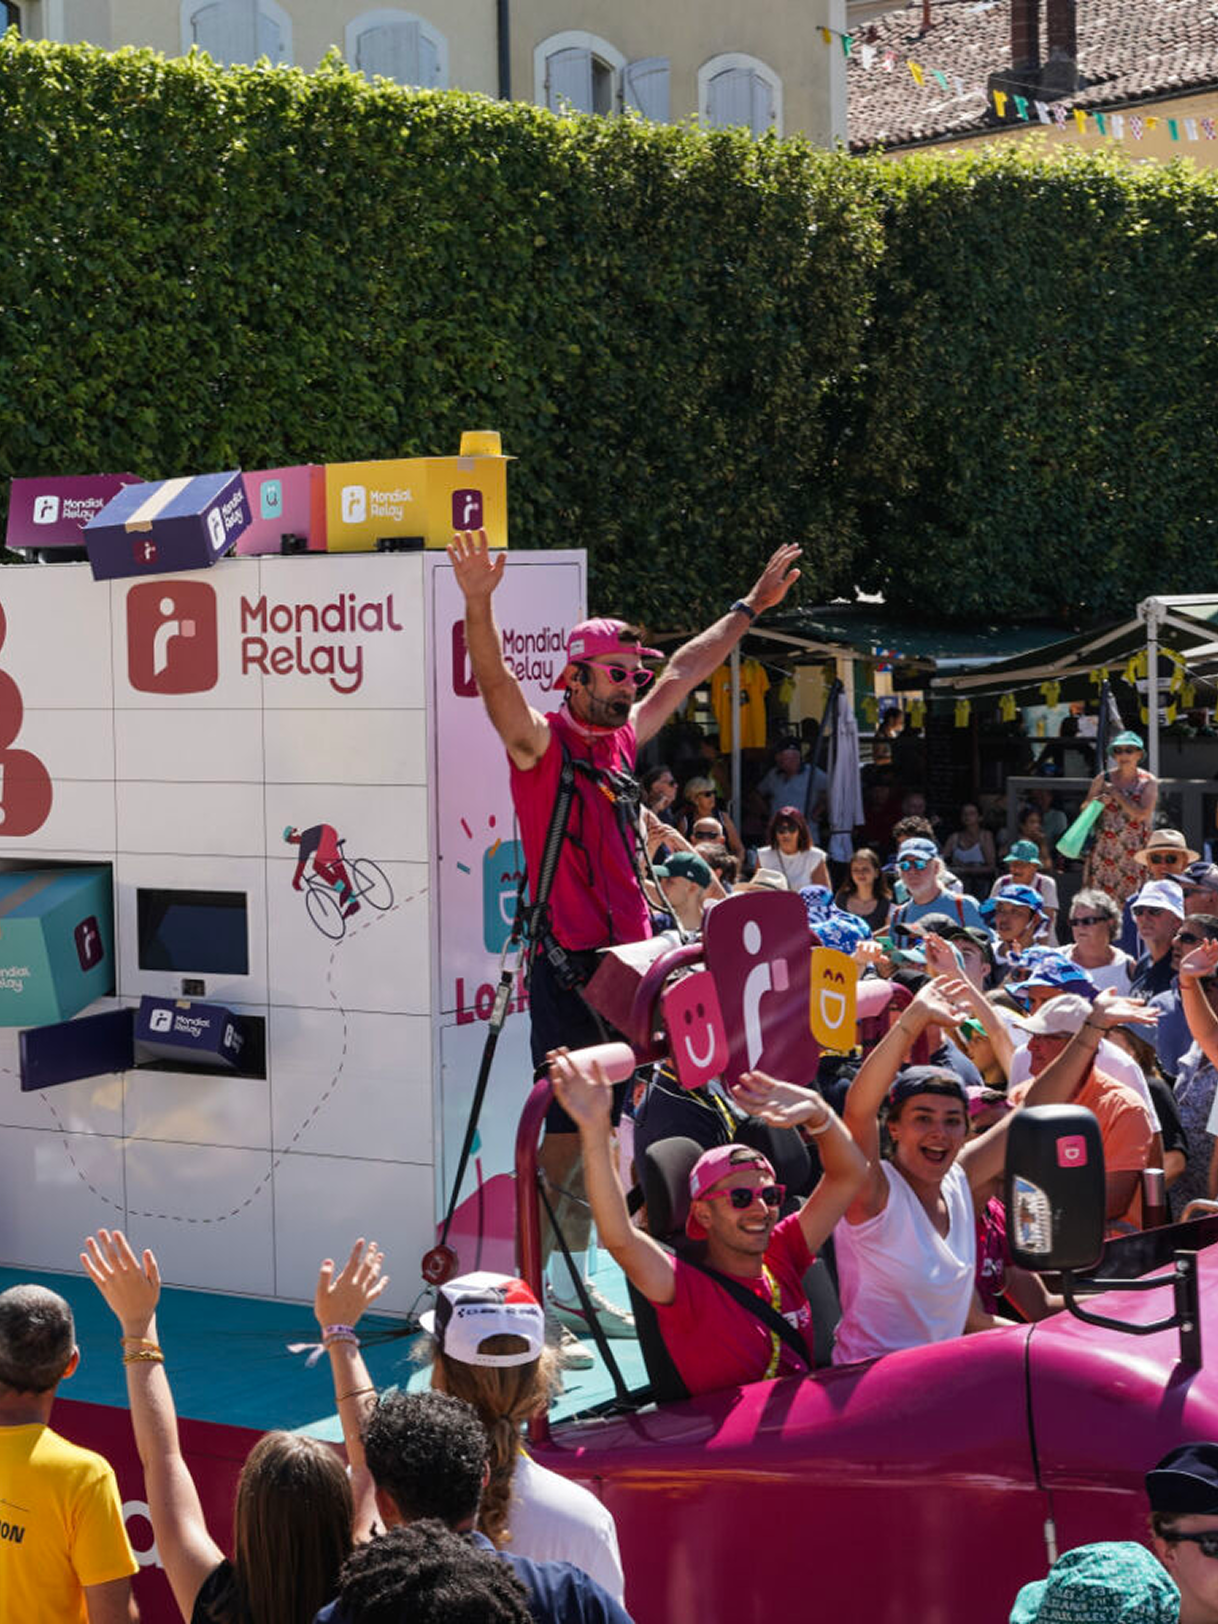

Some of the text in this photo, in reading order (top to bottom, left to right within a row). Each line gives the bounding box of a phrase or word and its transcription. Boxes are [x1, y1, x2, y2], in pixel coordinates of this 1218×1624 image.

[63, 498, 103, 508] Mondial
[222, 489, 244, 518] Mondial
[370, 489, 411, 503] Mondial
[371, 504, 403, 521] Relay
[240, 593, 404, 634] Mondial
[502, 627, 568, 655] Mondial
[241, 636, 363, 694] Relay
[174, 1021, 202, 1038] Relay
[175, 1015, 211, 1028] Mondial
